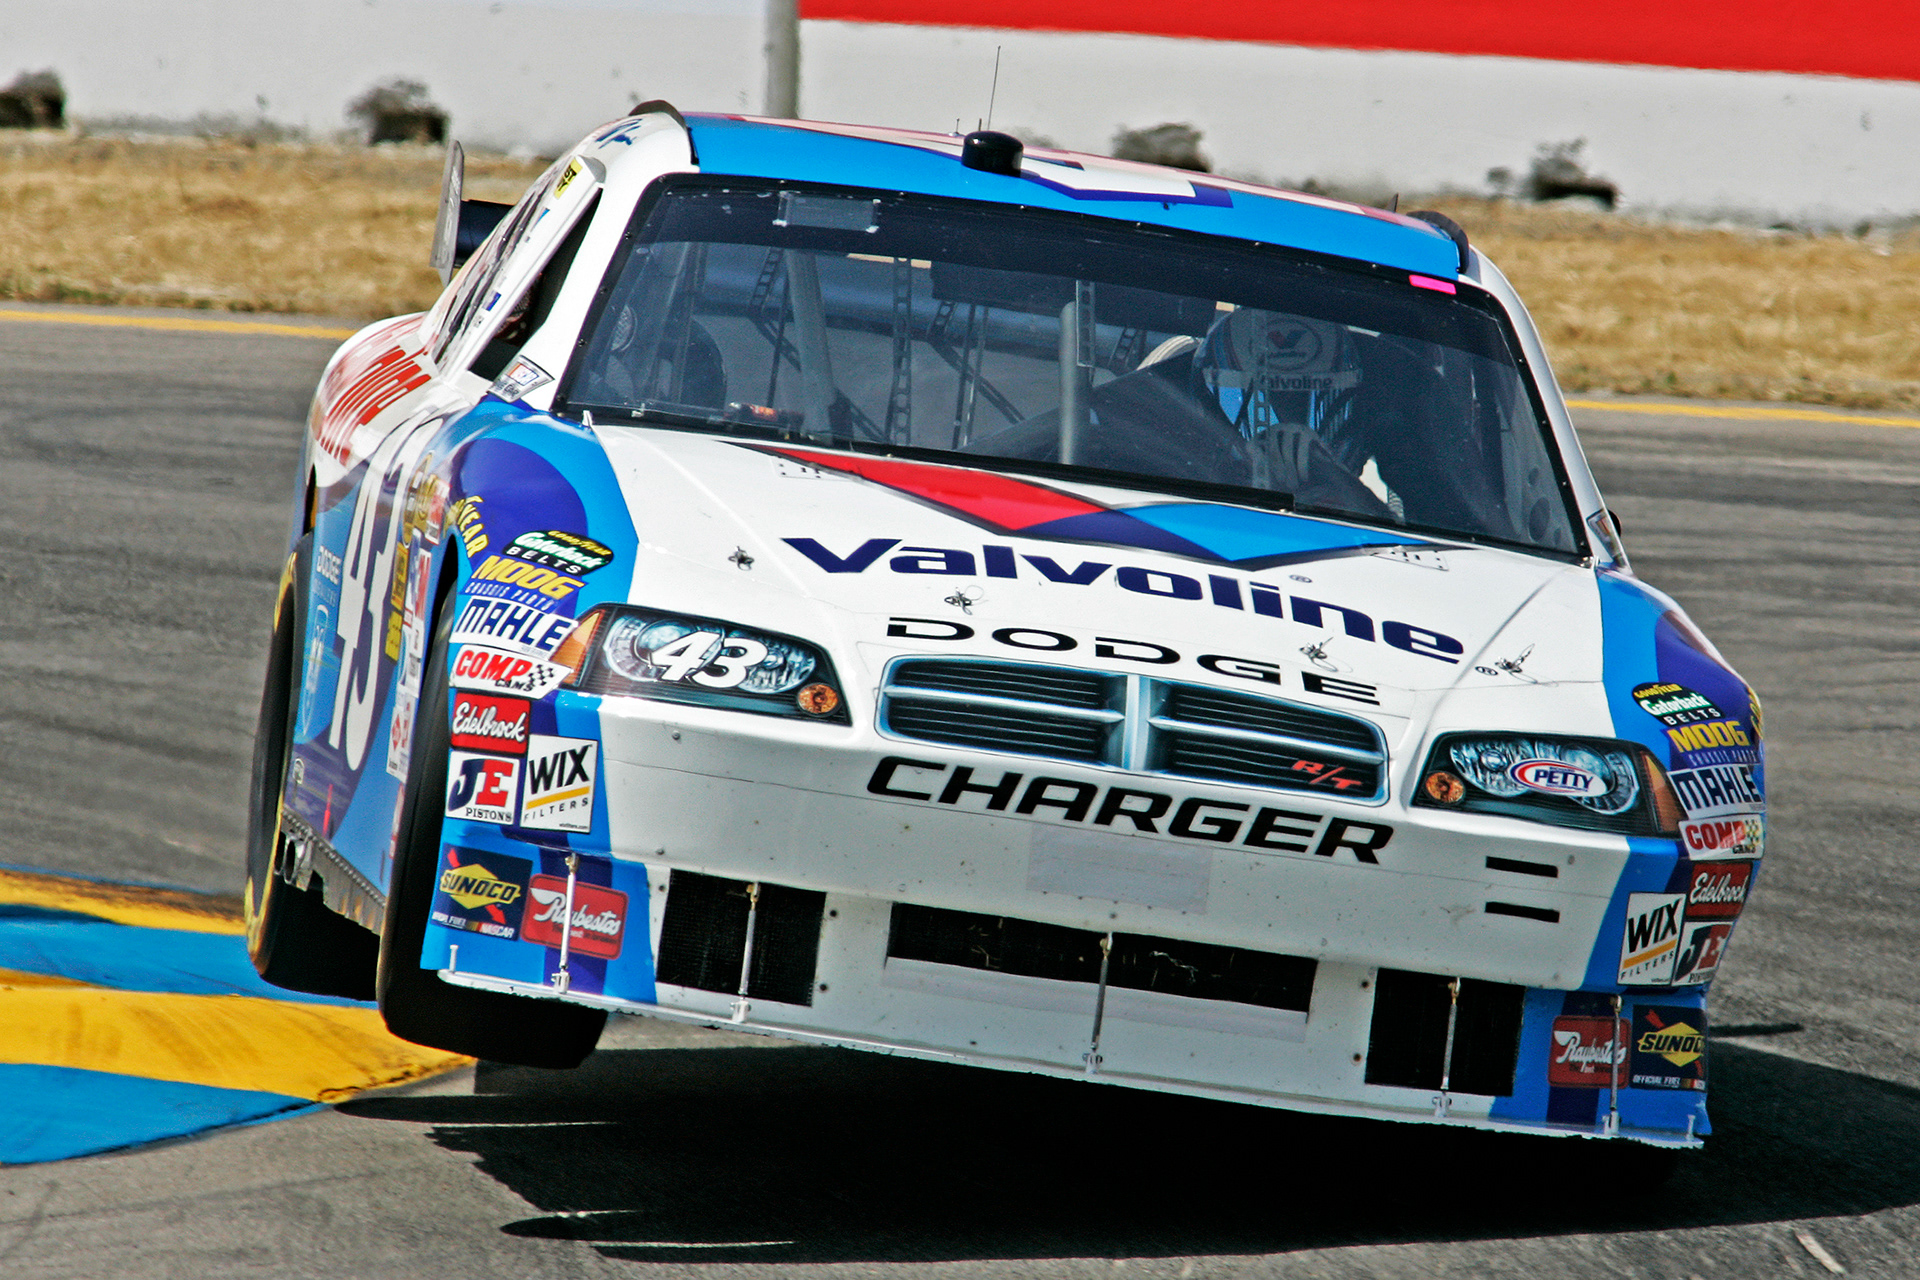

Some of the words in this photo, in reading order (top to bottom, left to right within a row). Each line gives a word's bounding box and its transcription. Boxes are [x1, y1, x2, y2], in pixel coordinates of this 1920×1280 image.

[506, 546, 582, 574] BELTS
[513, 532, 603, 569] Gatorback
[471, 555, 585, 600] MOOG
[511, 587, 553, 611] PARTS
[780, 537, 1464, 665] Valvoline
[455, 598, 572, 651] MAHLE
[455, 650, 533, 682] COMP
[650, 631, 769, 689] 43
[886, 617, 1381, 706] DODGE
[494, 678, 536, 692] CAMS
[1639, 692, 1712, 717] Gatorback
[1662, 707, 1722, 726] BELTS
[452, 702, 527, 743] Edelbrock
[1667, 720, 1750, 753] MOOG
[448, 758, 514, 812] JE
[529, 744, 593, 795] WIX
[1291, 759, 1362, 790] R/T
[1533, 769, 1594, 790] PETTY
[1670, 766, 1763, 811] MAHLE
[465, 807, 513, 822] PISTONS
[523, 797, 589, 823] FILTERS
[866, 756, 1394, 865] CHARGER
[1685, 820, 1746, 850] COMP
[441, 872, 518, 902] SUNOCO
[1689, 871, 1749, 904] Edelbrock
[480, 923, 515, 939] NASCAR
[1628, 897, 1682, 953] WIX
[1620, 950, 1675, 980] FILTERS
[1674, 923, 1733, 982] JE
